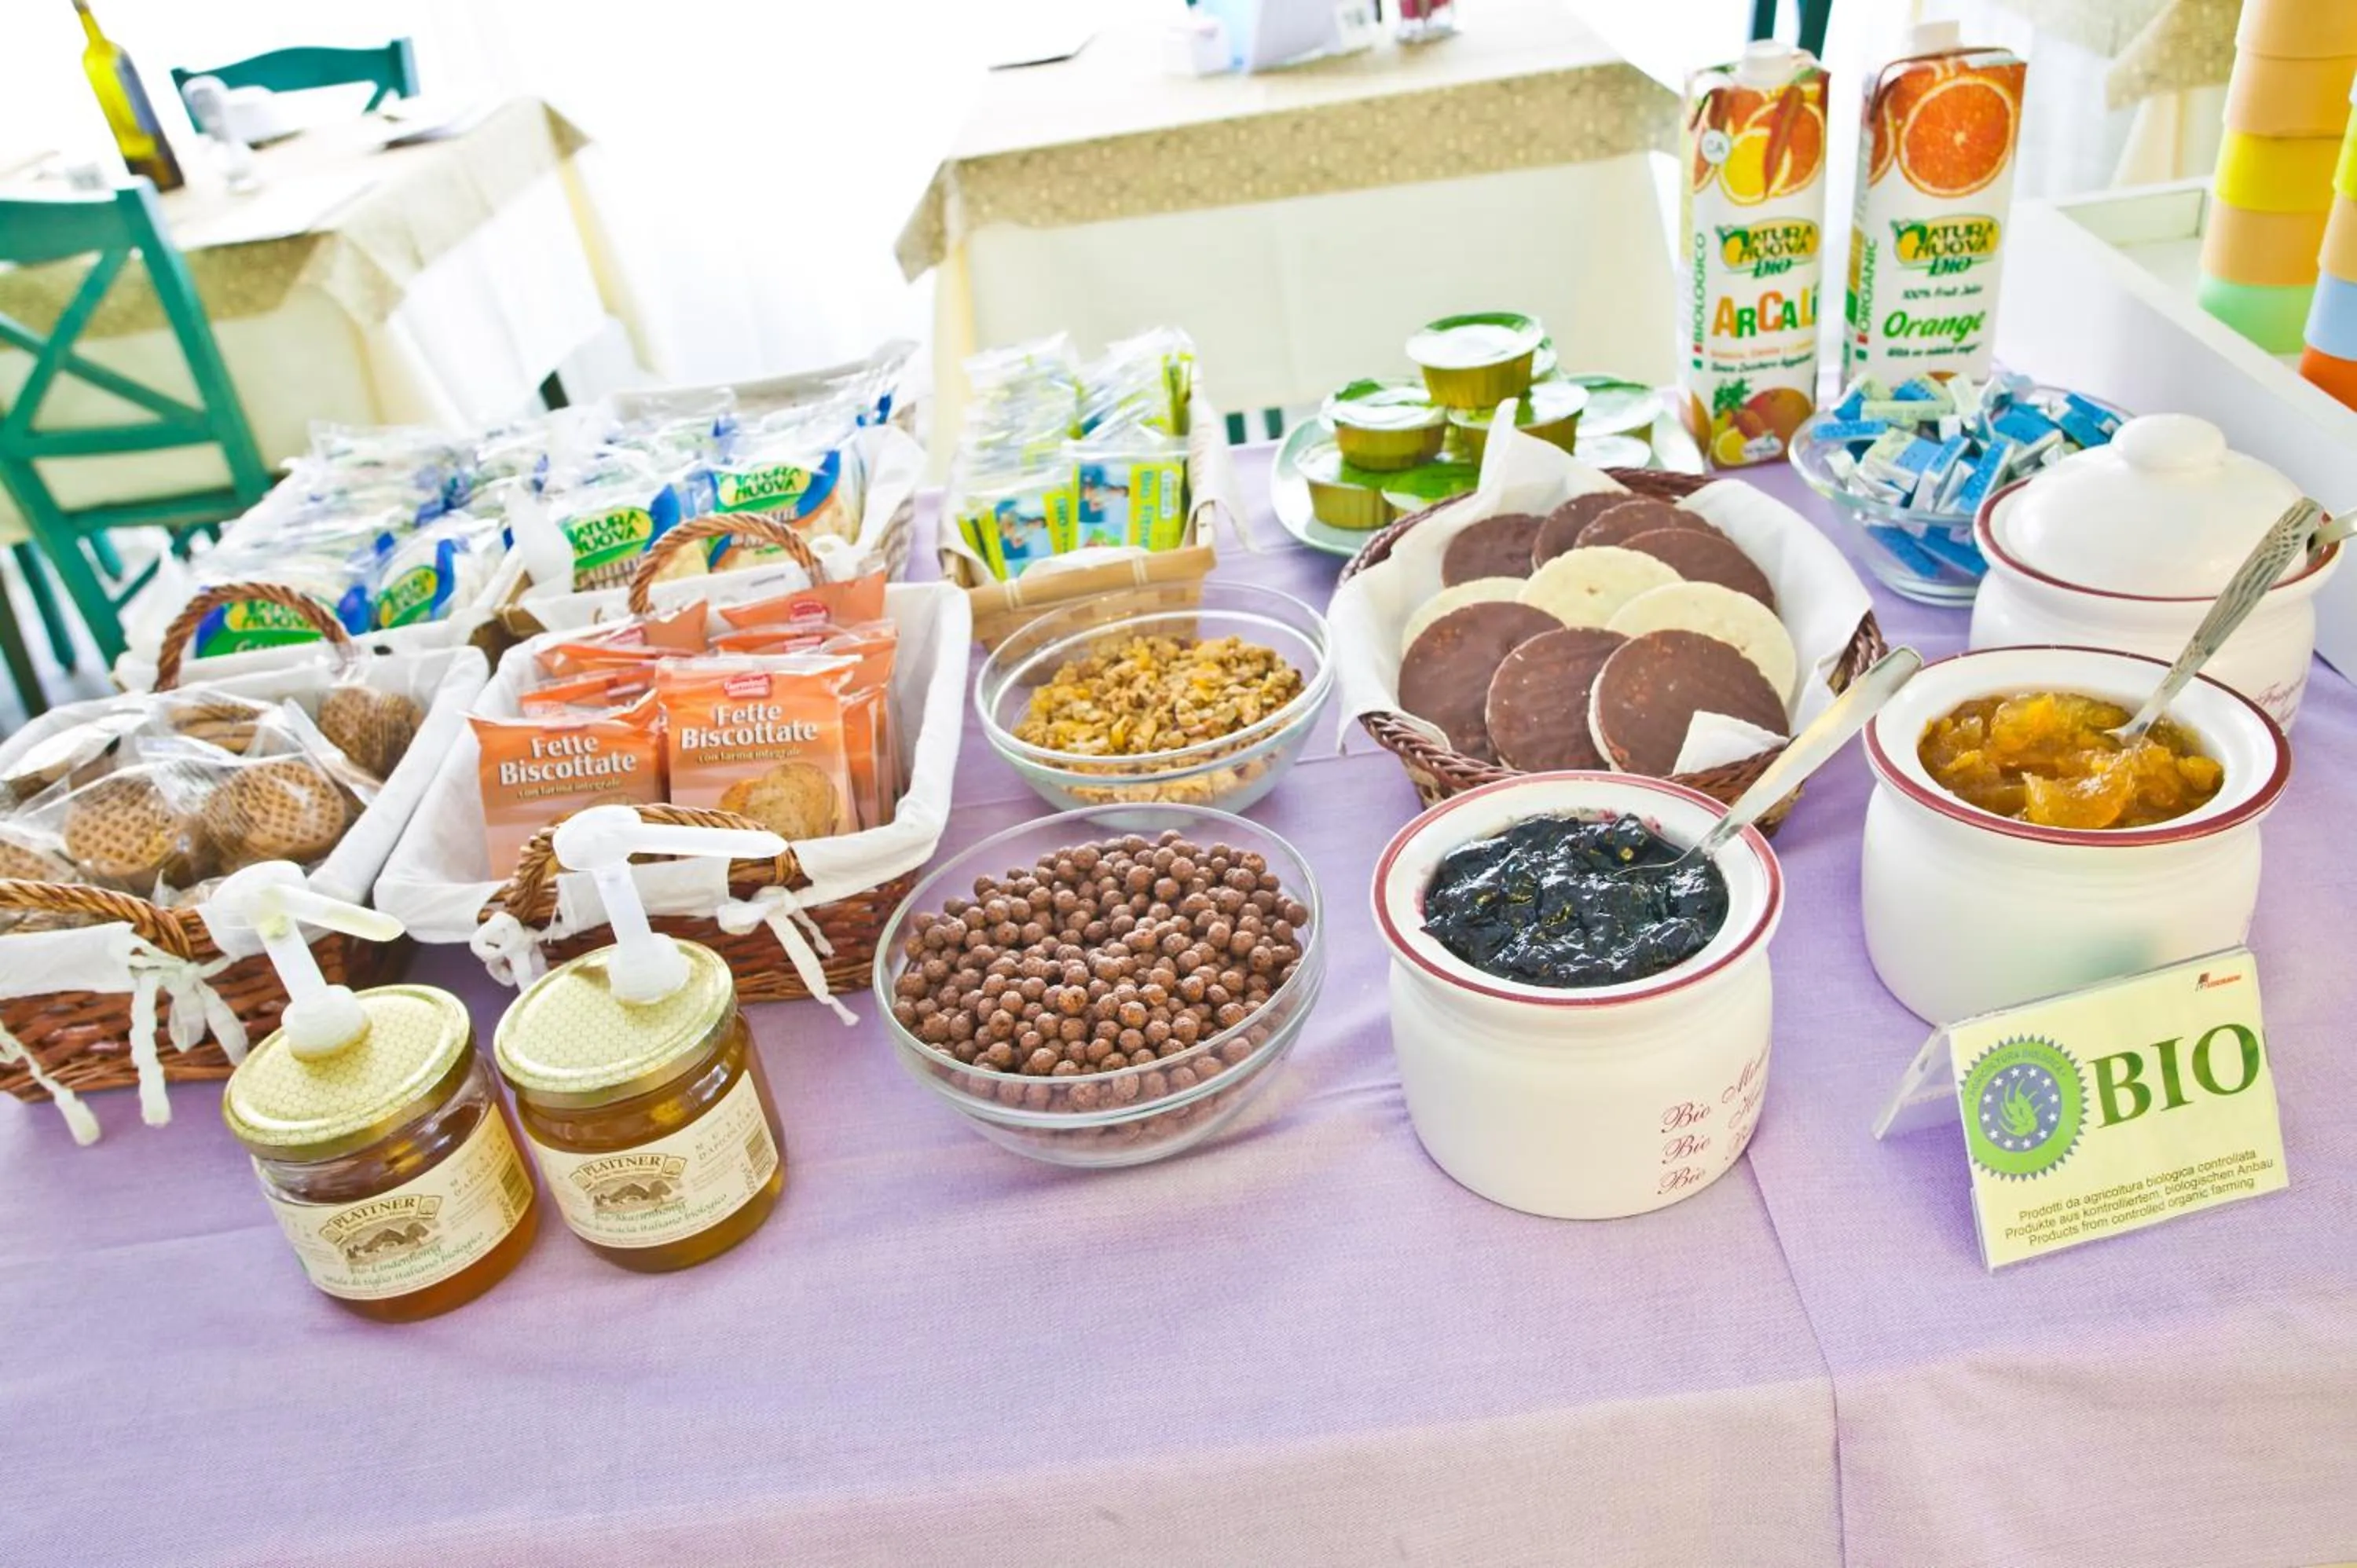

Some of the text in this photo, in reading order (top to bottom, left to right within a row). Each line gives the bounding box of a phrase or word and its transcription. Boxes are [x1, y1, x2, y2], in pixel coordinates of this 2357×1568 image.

[1912, 239, 1989, 260] NUOVA
[1693, 232, 1706, 343] BIOLOGICO
[1858, 236, 1878, 333] ORGANIC
[716, 702, 783, 727] Fette
[531, 735, 599, 759] Fette
[681, 719, 819, 750] Biscottate
[500, 751, 638, 786] Biscottate
[2087, 1023, 2260, 1129] BIO
[1659, 1101, 1710, 1133] Bio
[1661, 1134, 1710, 1164] Bio
[2005, 1217, 2057, 1240] Produkte
[2059, 1212, 2080, 1225] aus
[2165, 1169, 2235, 1196] biologischen
[2237, 1158, 2274, 1176] Anbau
[2018, 1149, 2256, 1222] Prodotti da agricoltura biologica controllata
[332, 1197, 416, 1229] PLATTNER
[2029, 1177, 2256, 1246] Products from controlled organic farming
